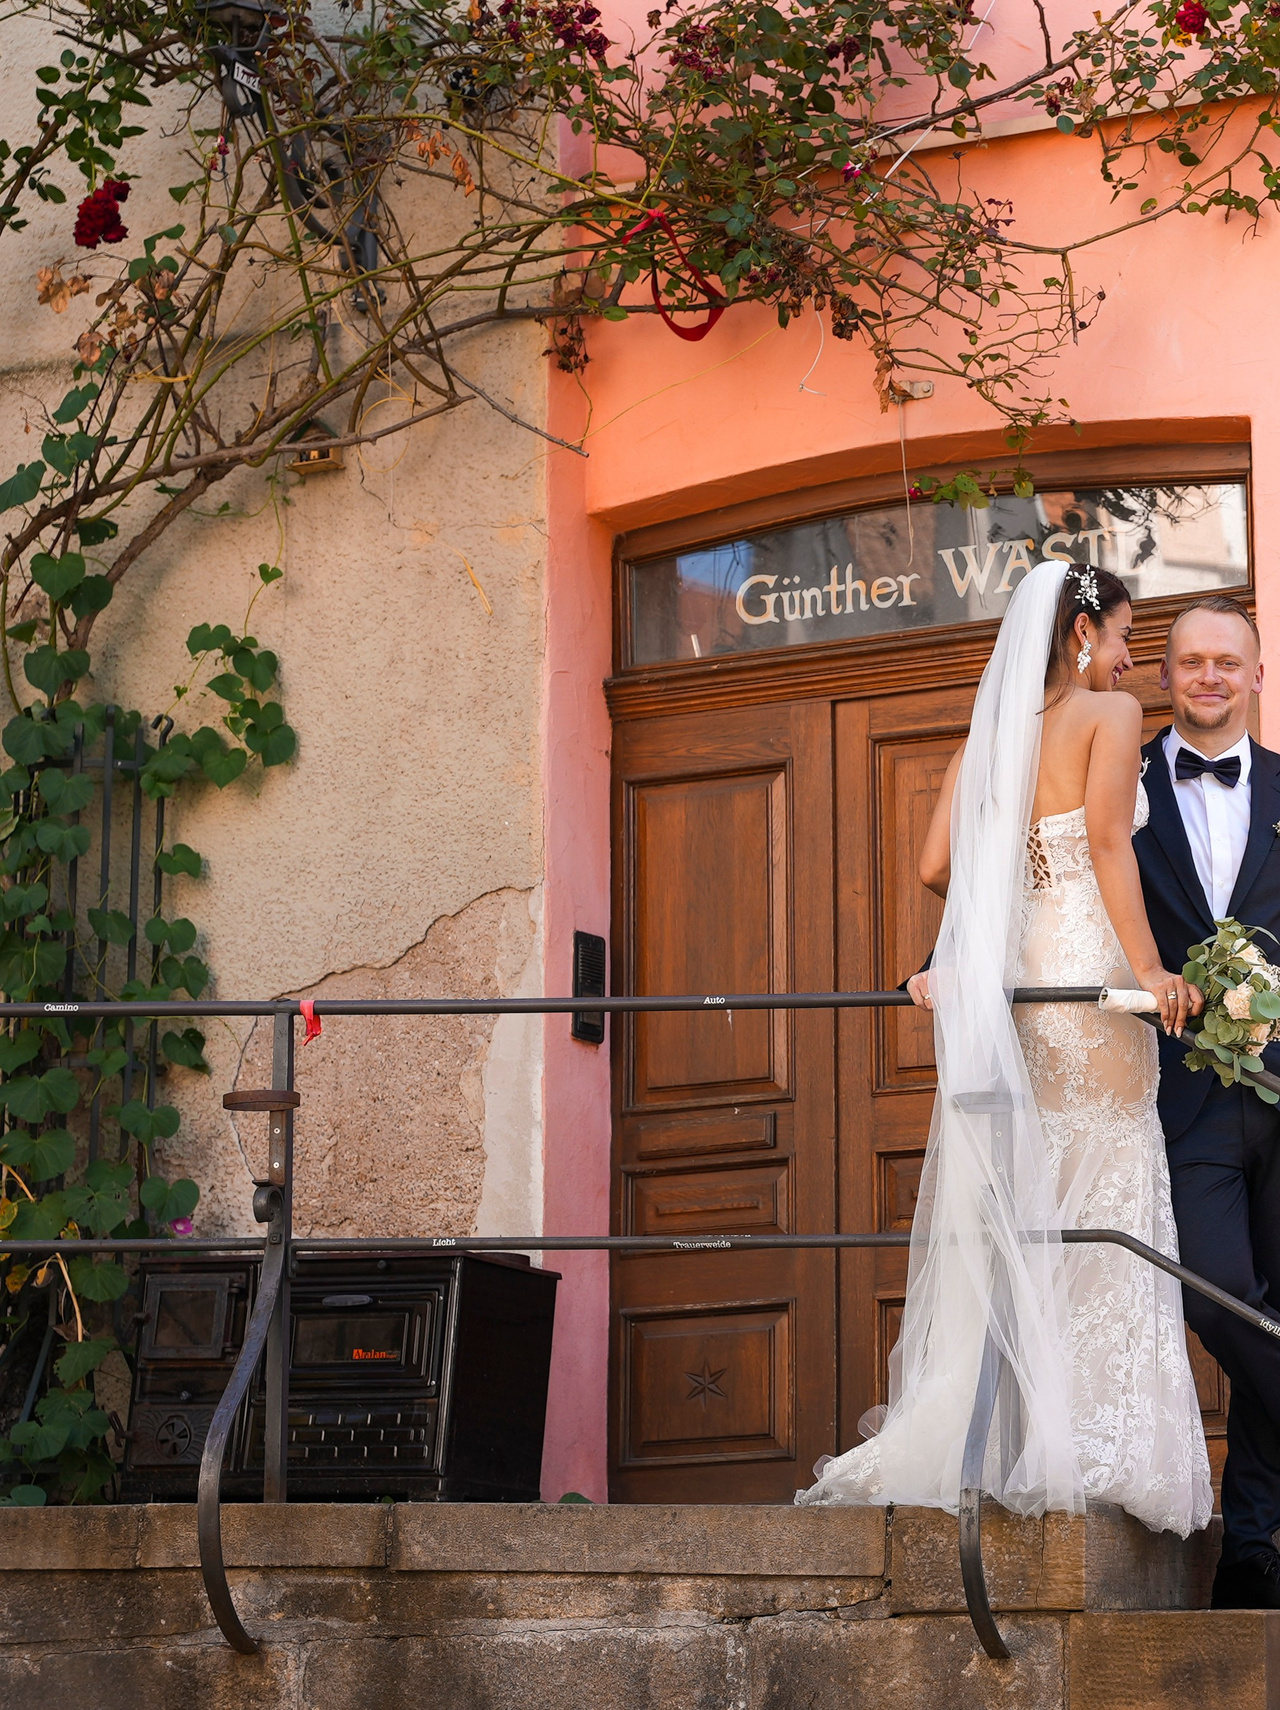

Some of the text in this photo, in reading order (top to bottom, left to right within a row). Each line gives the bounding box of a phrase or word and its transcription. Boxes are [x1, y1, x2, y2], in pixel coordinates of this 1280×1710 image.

[735, 562, 921, 625] Günther
[703, 996, 726, 1005] Auto
[43, 1003, 79, 1012] Camino
[432, 1238, 457, 1247] Licht
[673, 1240, 732, 1249] Trauerweide
